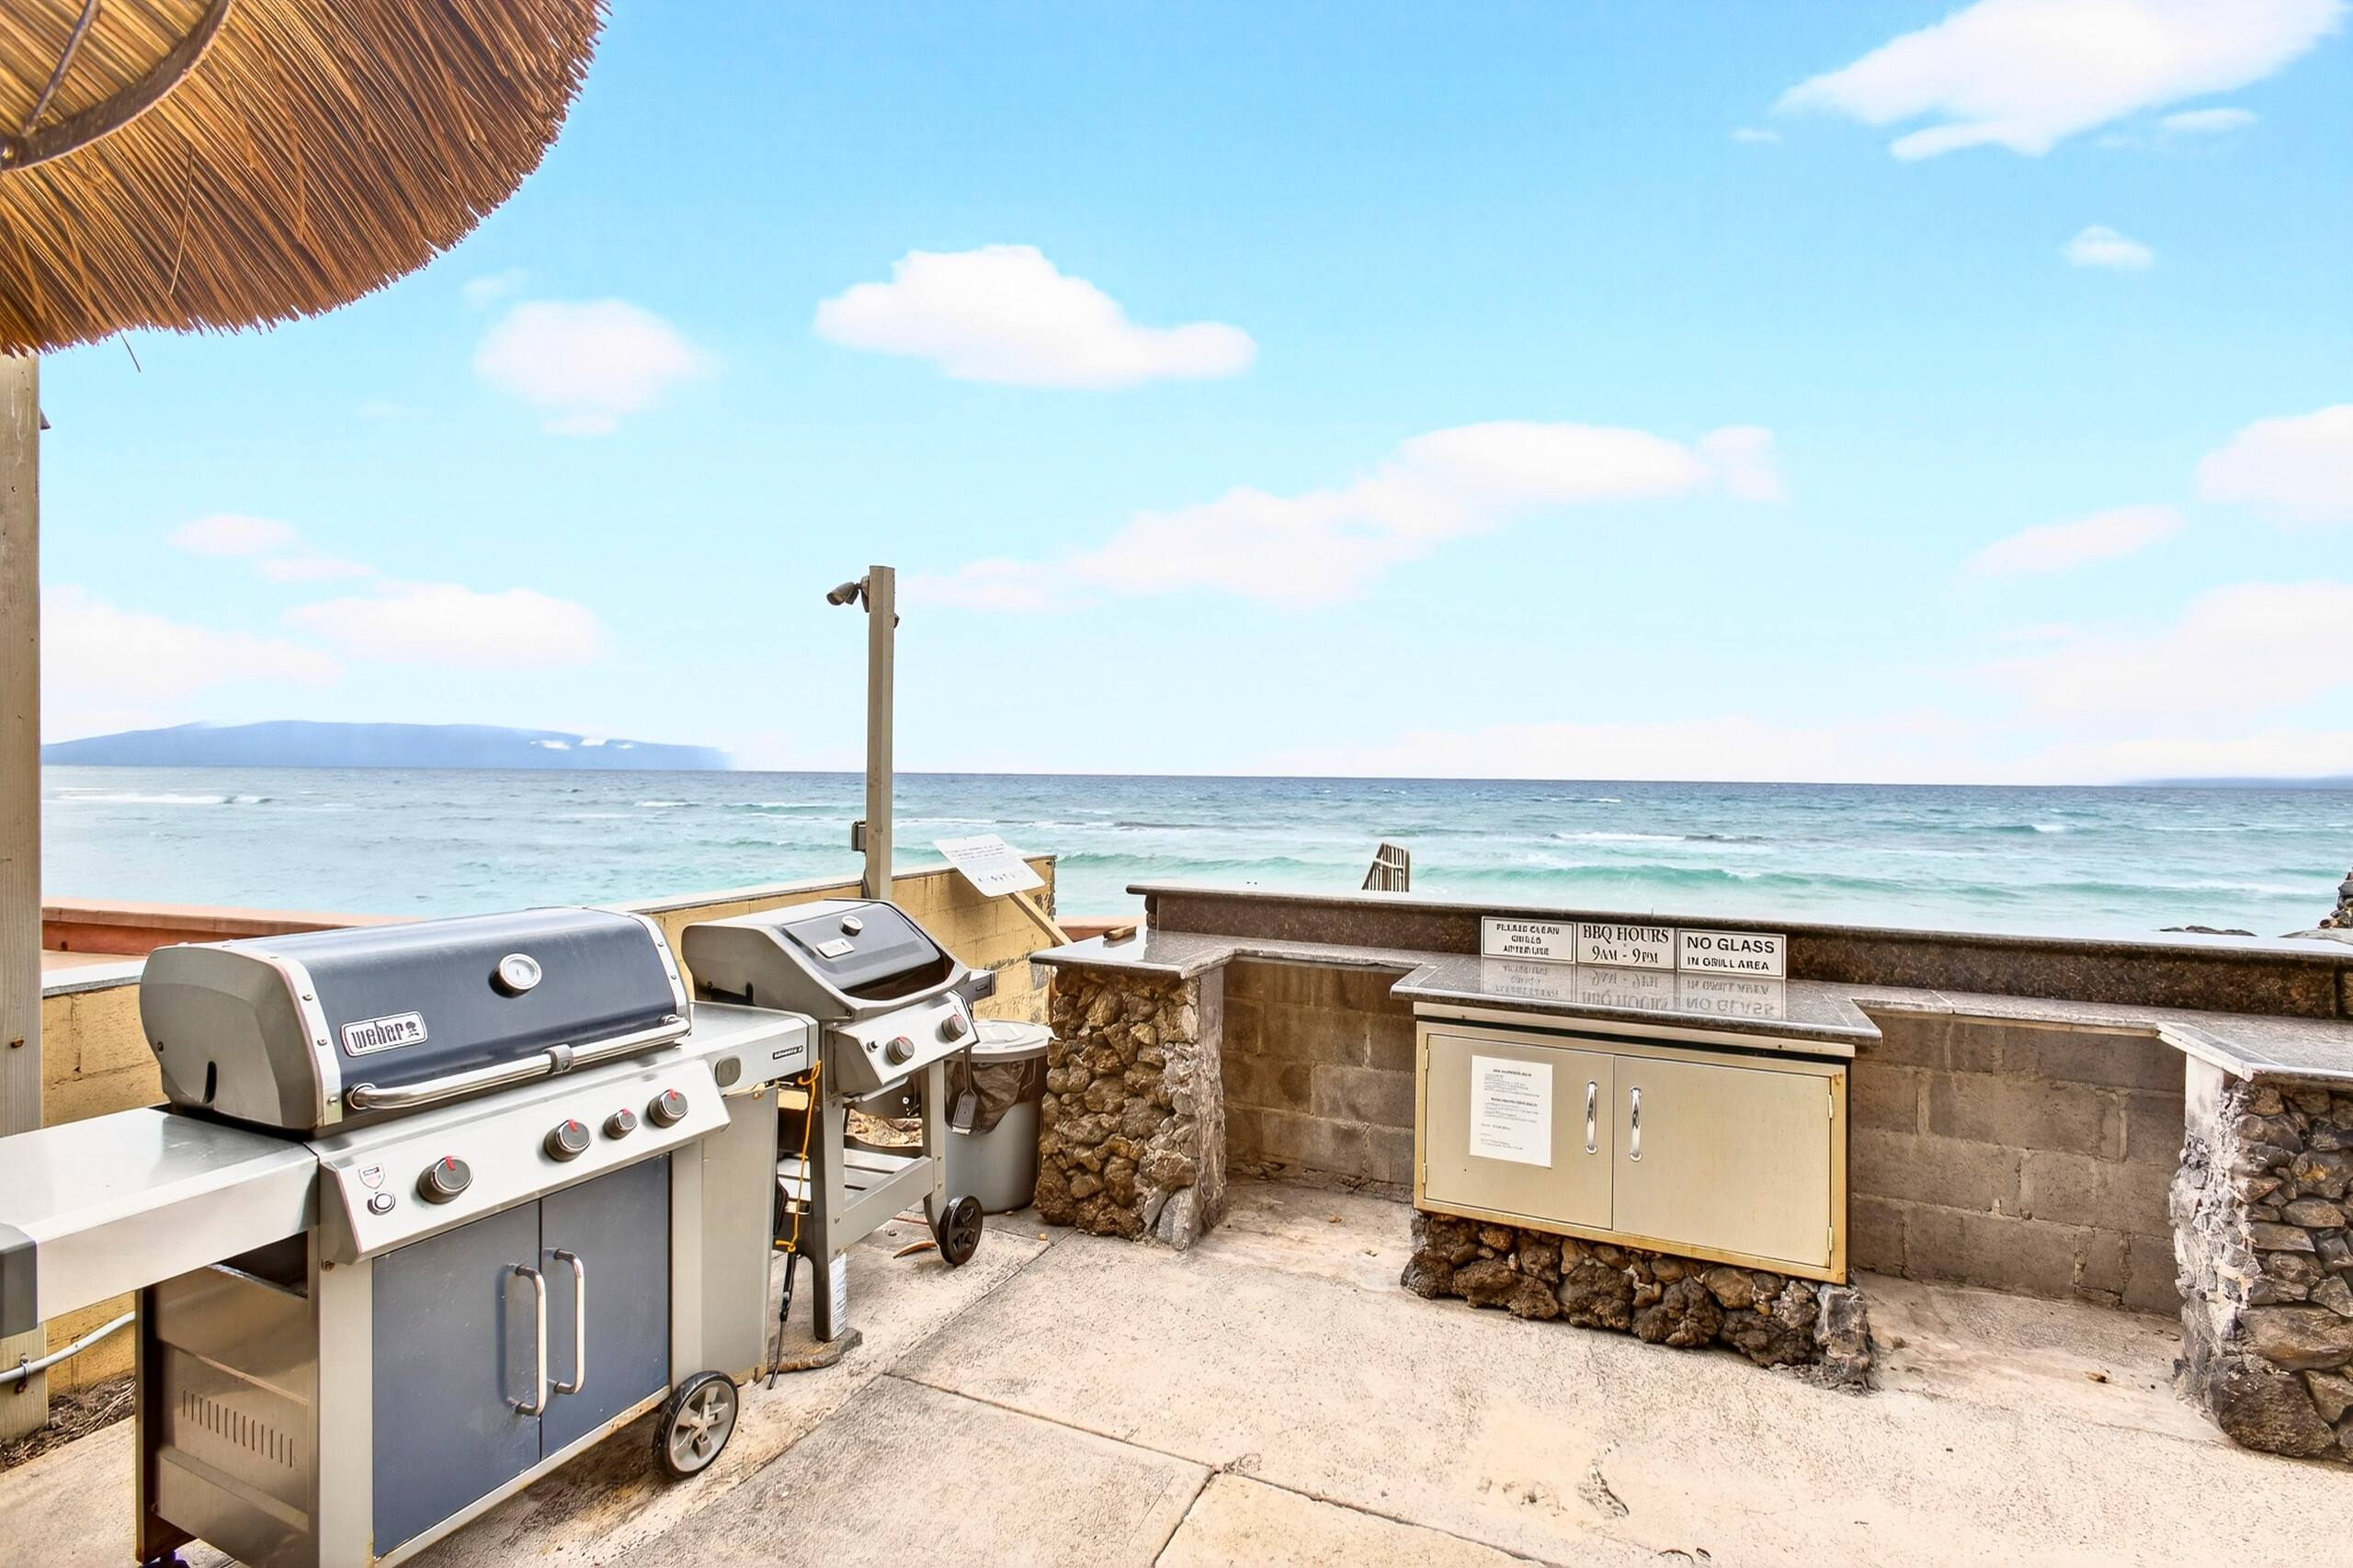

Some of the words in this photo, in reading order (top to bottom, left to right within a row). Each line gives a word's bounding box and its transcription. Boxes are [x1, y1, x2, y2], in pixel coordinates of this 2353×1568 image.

[1529, 926, 1560, 935] CLEAN
[1583, 925, 1611, 944] BBQ
[1618, 926, 1668, 944] HOURS
[1592, 945, 1618, 961] 9AM
[1632, 948, 1658, 963] 9PM
[1687, 936, 1711, 949] NO
[1717, 937, 1775, 954] GLASS
[1687, 956, 1699, 966] IN
[1702, 957, 1735, 969] GRILL
[1737, 960, 1769, 971] AREA
[351, 1020, 404, 1049] weber
